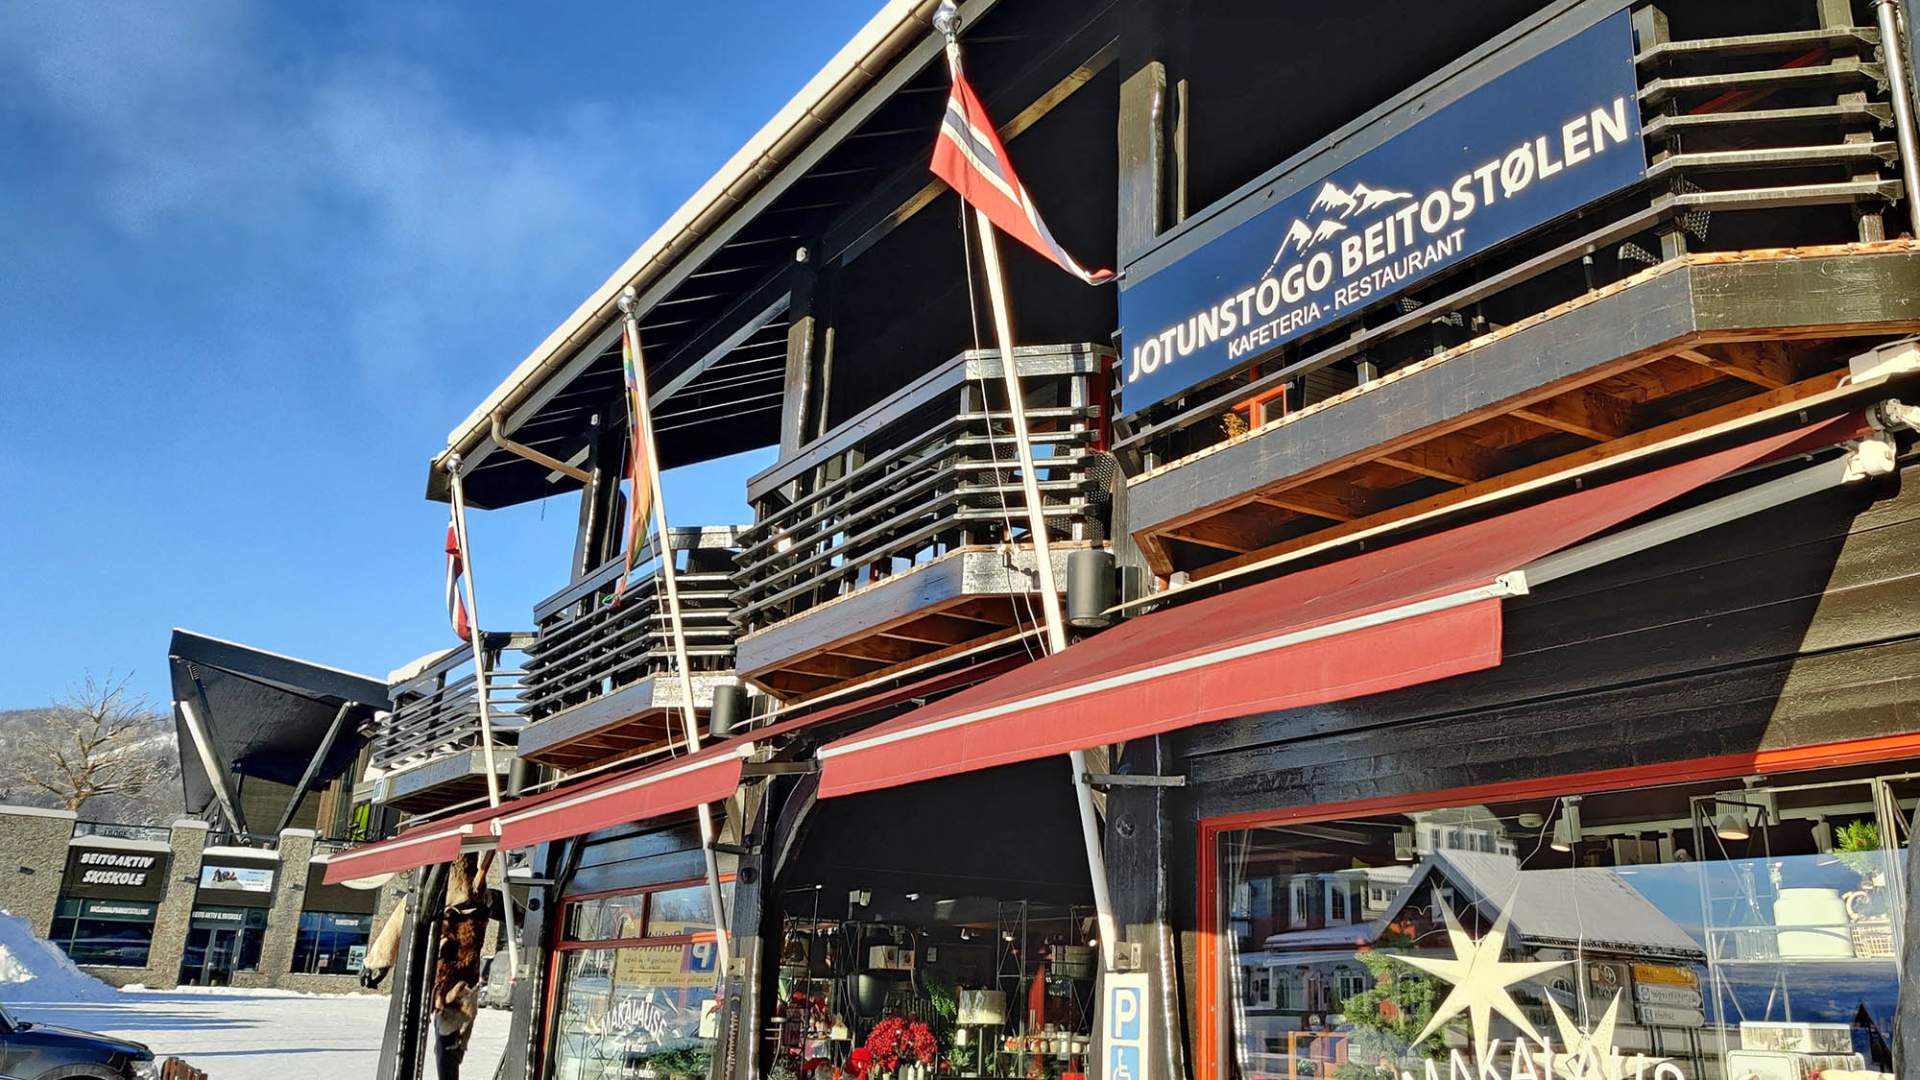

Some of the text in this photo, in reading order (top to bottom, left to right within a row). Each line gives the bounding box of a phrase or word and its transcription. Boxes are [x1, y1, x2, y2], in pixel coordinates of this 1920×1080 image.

[1128, 97, 1629, 383] JOTUNSTOGO BEITOSTØLEN
[1229, 302, 1321, 360] KAFETERIA
[1334, 229, 1466, 310] RESTAURANT
[80, 853, 155, 868] BEITOAKTIV
[82, 870, 146, 886] SKISKOLE
[1115, 989, 1137, 1038] P
